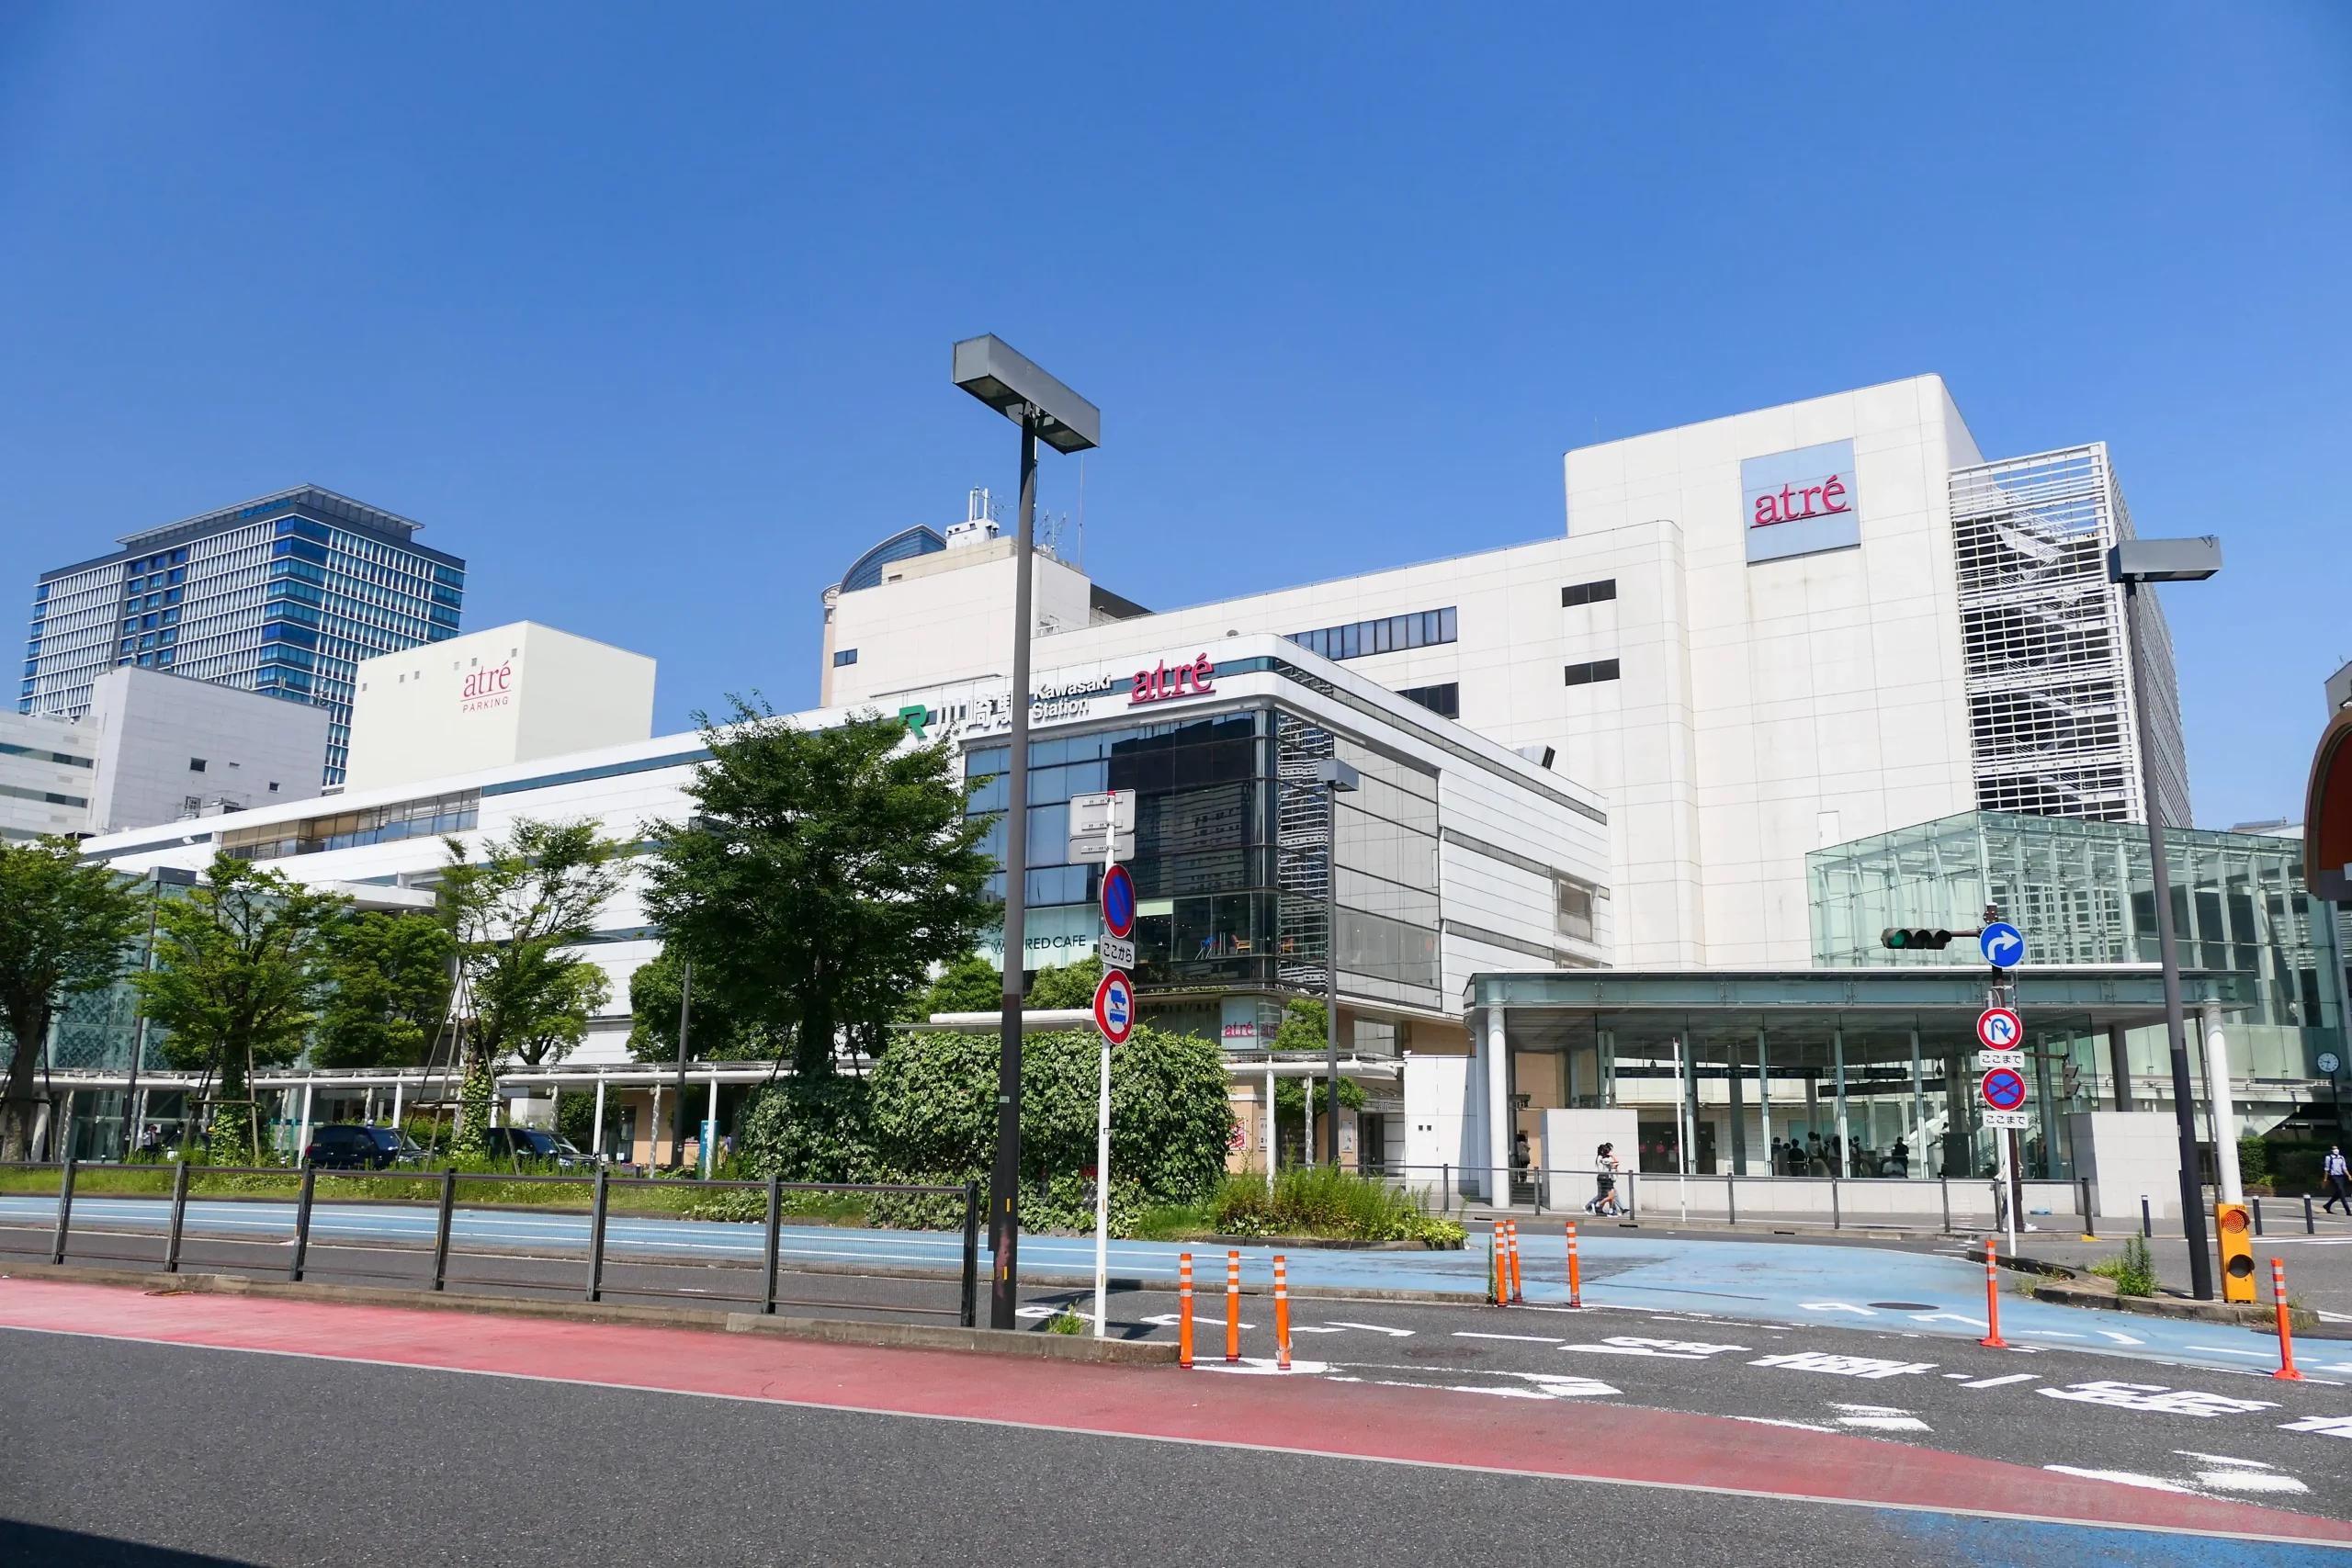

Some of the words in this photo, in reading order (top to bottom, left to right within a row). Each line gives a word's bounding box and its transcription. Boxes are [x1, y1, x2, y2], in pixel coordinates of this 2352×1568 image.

[1755, 474, 1846, 525] atré
[463, 660, 511, 697] atré
[1034, 672, 1112, 700] Kawasaki
[1131, 652, 1214, 701] atré
[462, 695, 509, 714] PARKING
[1032, 697, 1090, 720] Station
[1052, 935, 1086, 948] CAFE
[1103, 942, 1132, 963] ここから
[1225, 1021, 1254, 1037] atré
[1982, 1055, 2022, 1064] ここまで
[1985, 1114, 2026, 1124] ここまで
